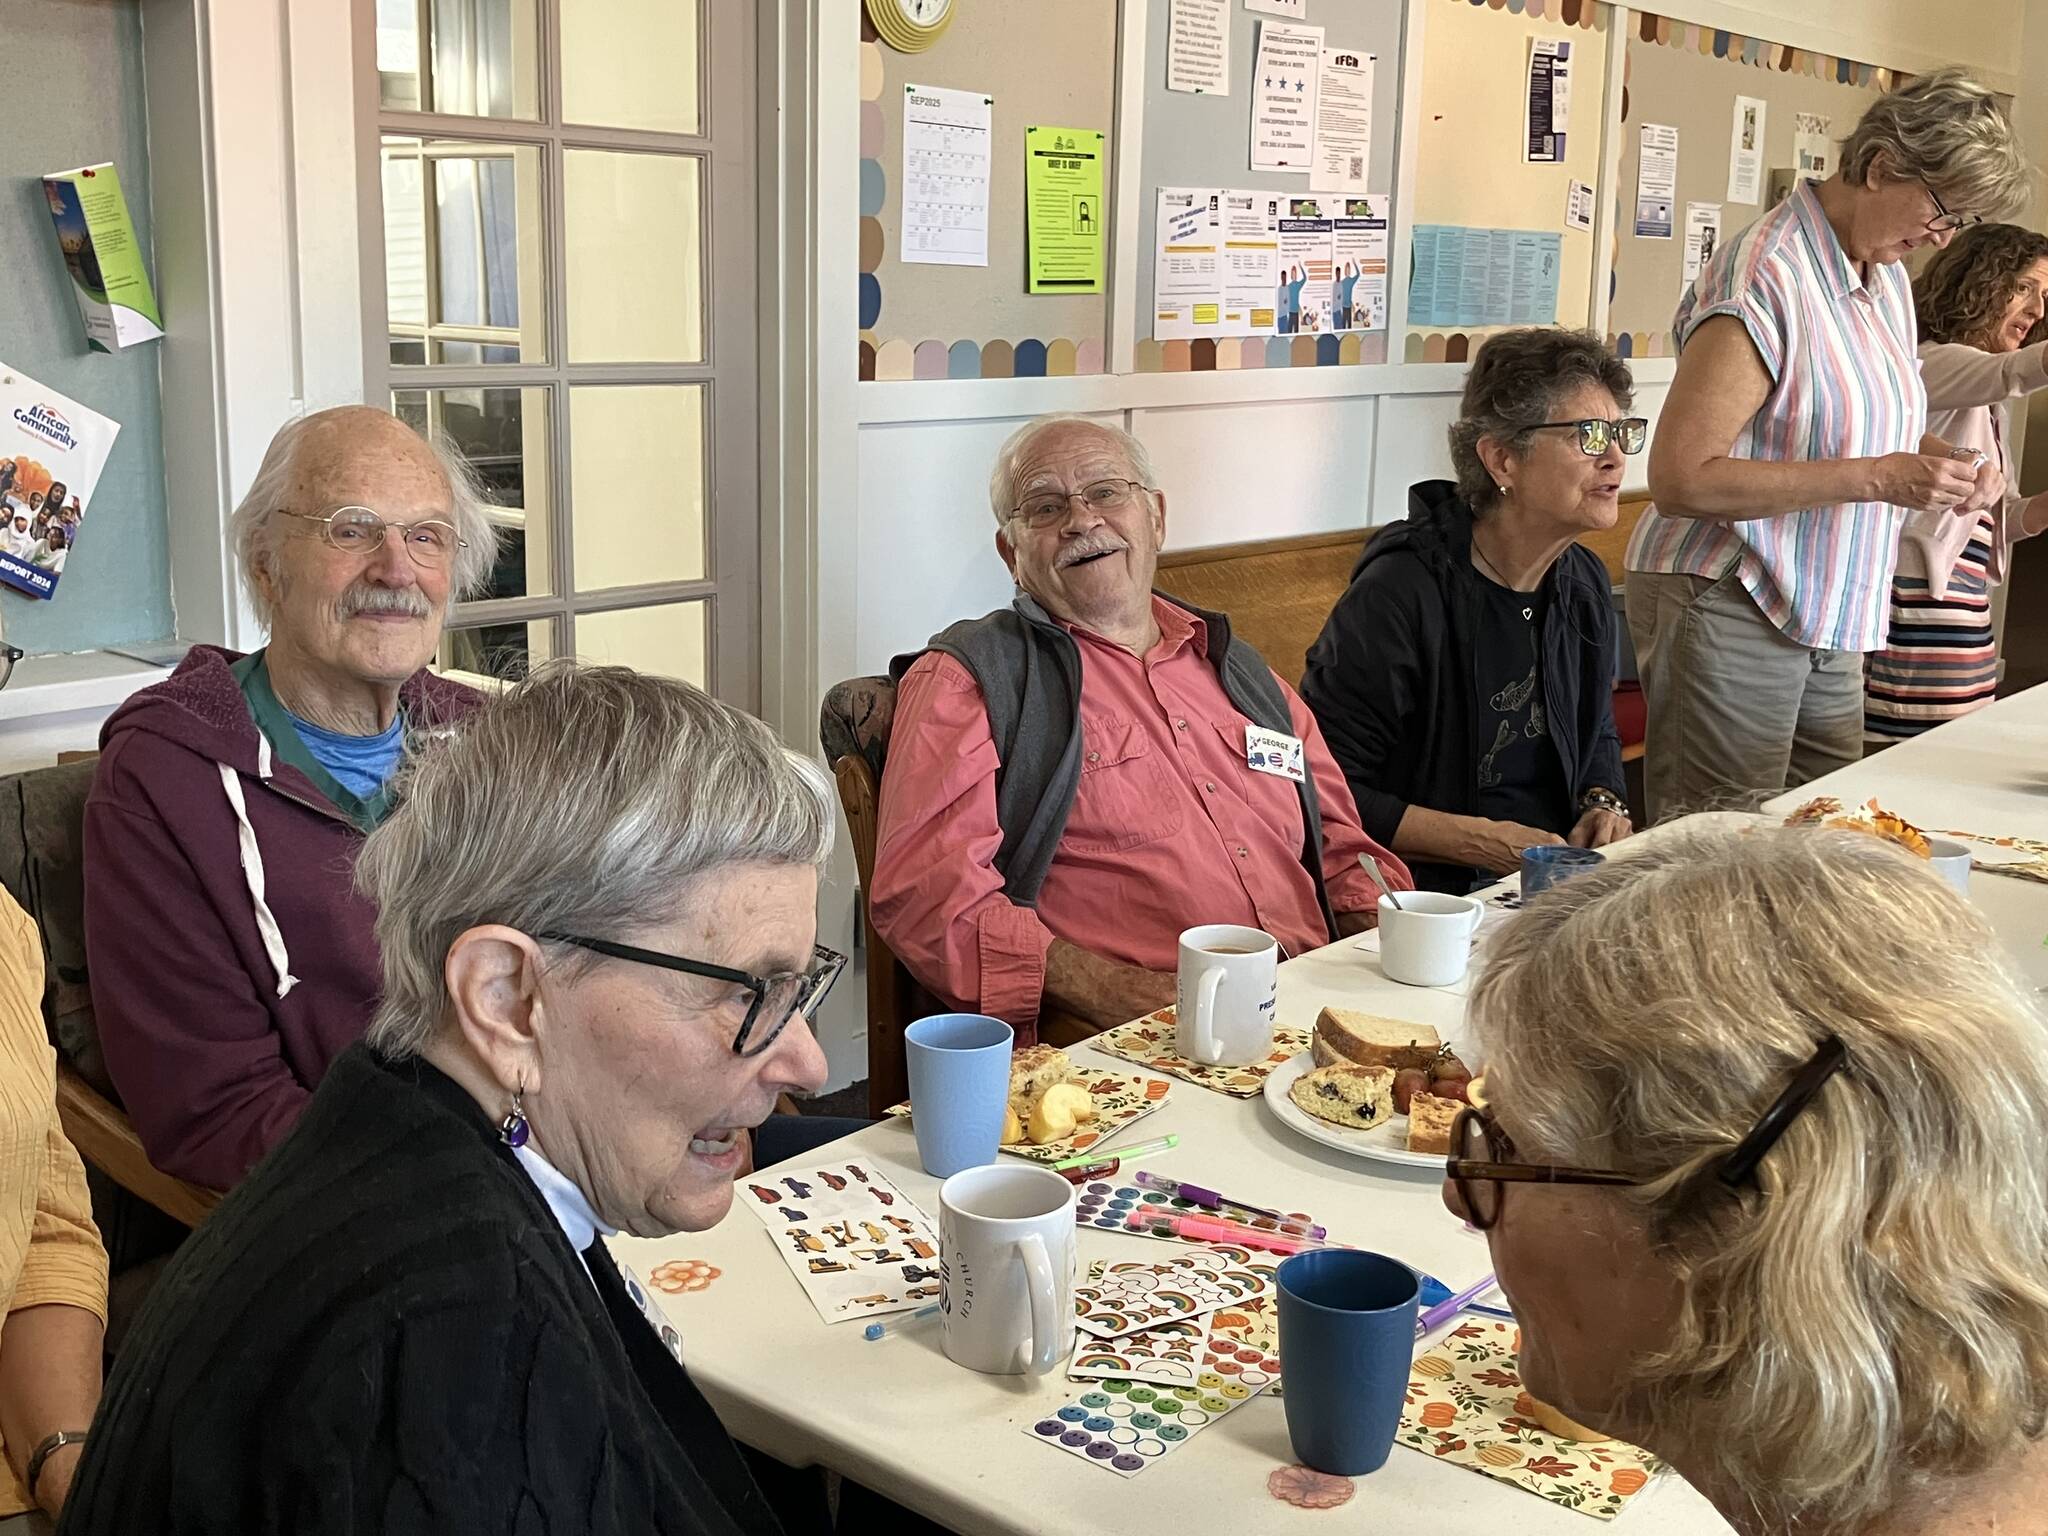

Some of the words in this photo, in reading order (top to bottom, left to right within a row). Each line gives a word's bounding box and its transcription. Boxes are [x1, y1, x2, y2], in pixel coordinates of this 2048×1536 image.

[13, 408, 78, 450] Community
[29, 405, 70, 433] African
[0, 558, 32, 579] REPORT
[31, 573, 52, 589] 2024
[1262, 738, 1289, 751] GEORGE
[955, 1251, 974, 1319] CHURCH
